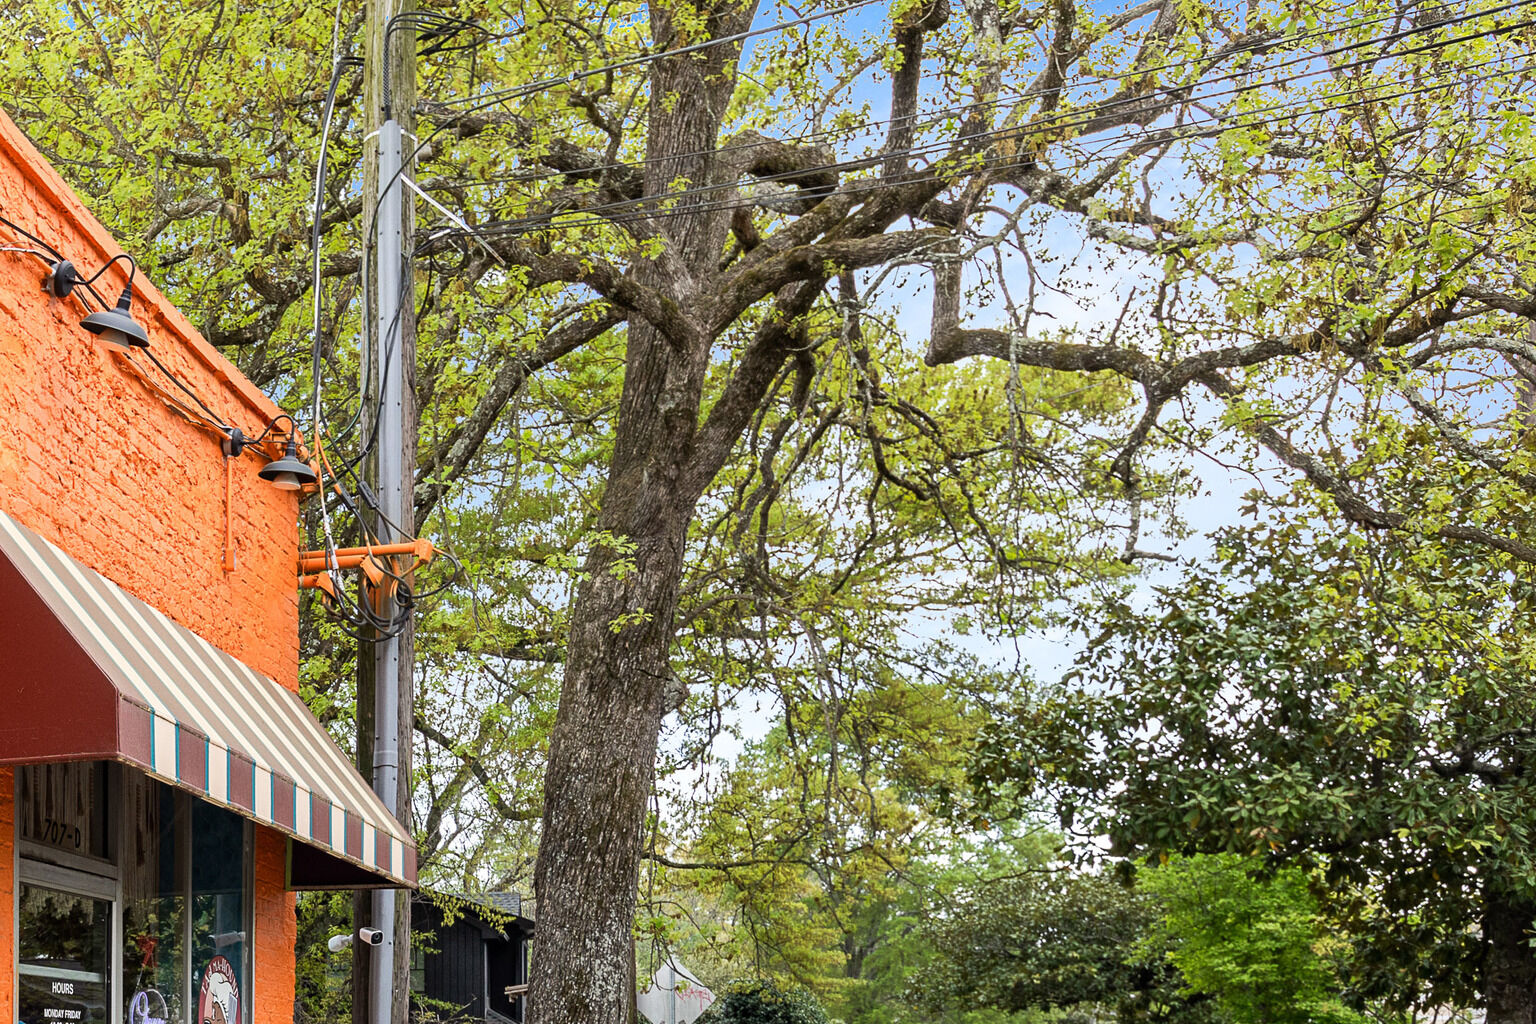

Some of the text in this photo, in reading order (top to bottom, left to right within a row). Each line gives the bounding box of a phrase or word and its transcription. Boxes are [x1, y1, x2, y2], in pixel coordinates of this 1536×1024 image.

[43, 818, 81, 849] 707-D
[51, 981, 74, 995] HOURS
[44, 1008, 81, 1020] MONDAY FRIDAY
